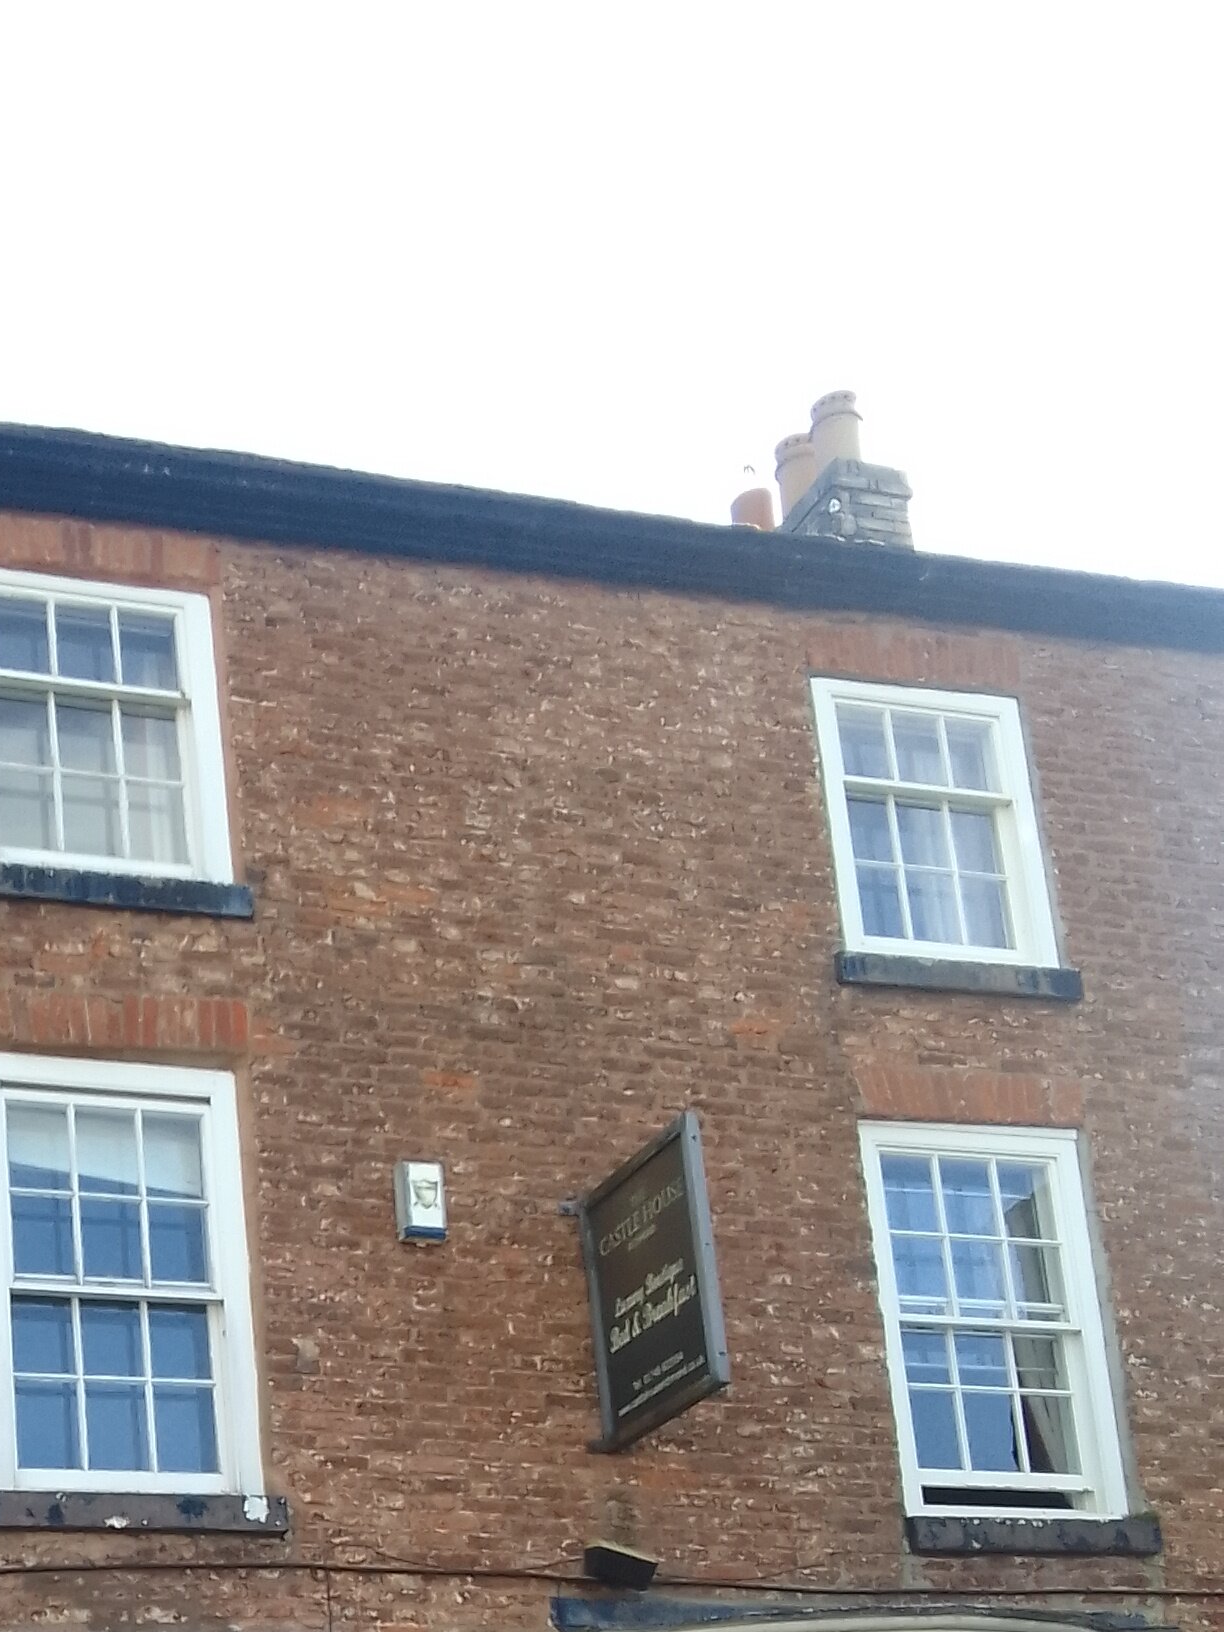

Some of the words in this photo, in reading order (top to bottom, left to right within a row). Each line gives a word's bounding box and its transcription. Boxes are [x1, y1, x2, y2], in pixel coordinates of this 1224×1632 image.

[610, 1318, 631, 1353] Bed
[632, 1311, 642, 1338] &
[642, 1274, 696, 1330] Breakfast
